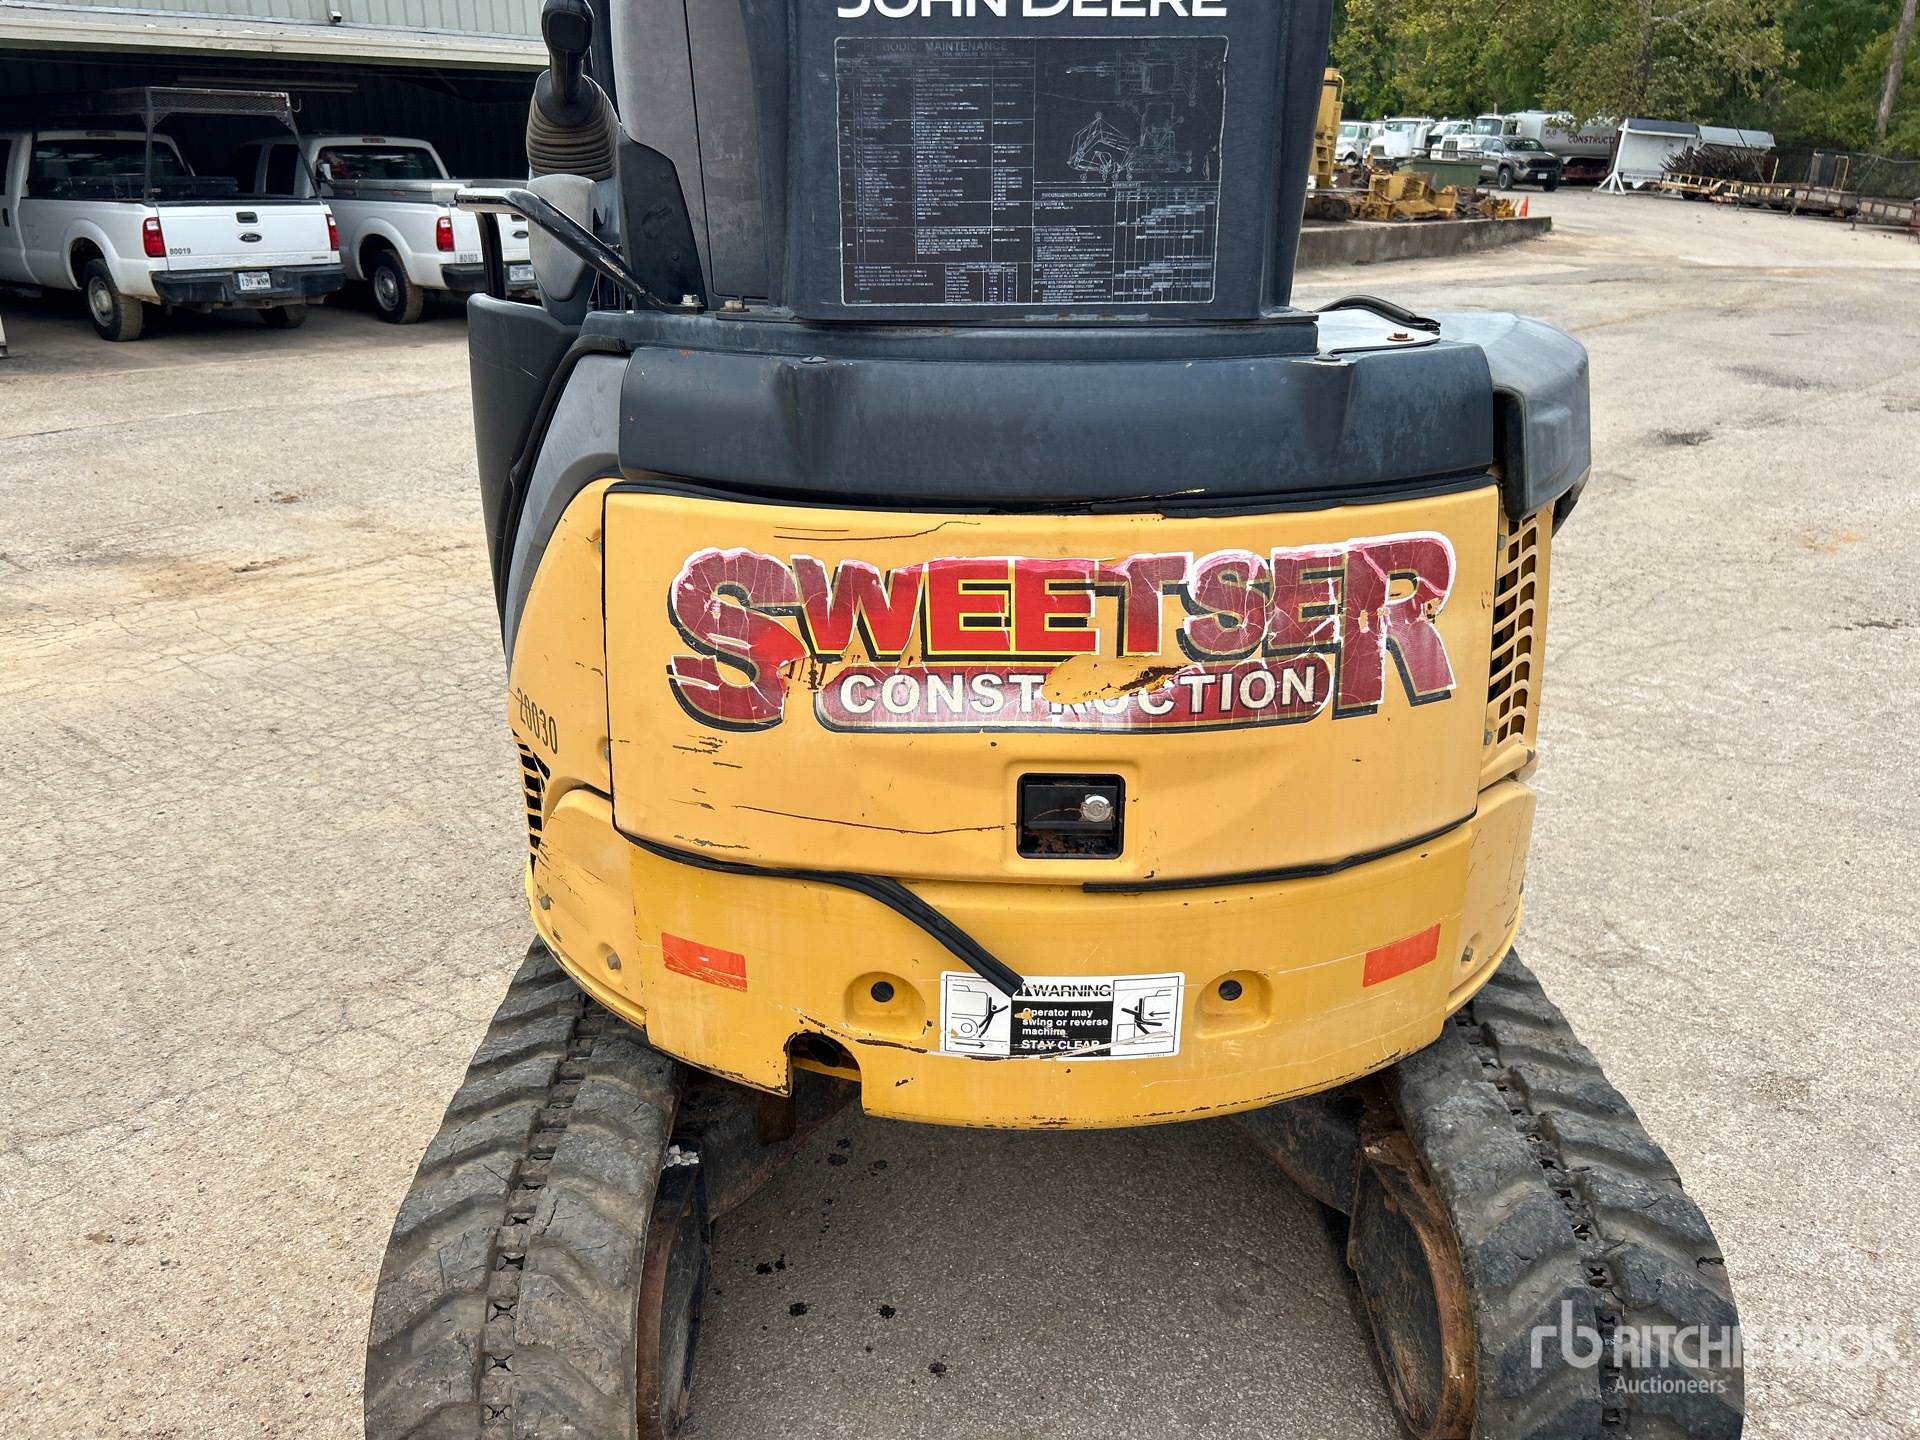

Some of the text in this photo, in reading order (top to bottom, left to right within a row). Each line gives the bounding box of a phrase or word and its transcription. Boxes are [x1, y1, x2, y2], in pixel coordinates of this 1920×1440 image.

[925, 41, 1008, 52] MAINTENANCE
[169, 247, 191, 255] 80019
[666, 531, 1457, 732] SWEETSER
[517, 687, 557, 754] 20030
[1033, 984, 1111, 997] WARNING
[1072, 1009, 1093, 1018] may
[1022, 1018, 1053, 1027] swing
[1070, 1018, 1108, 1026] reverse
[1021, 1040, 1100, 1050] STAY CLEAR
